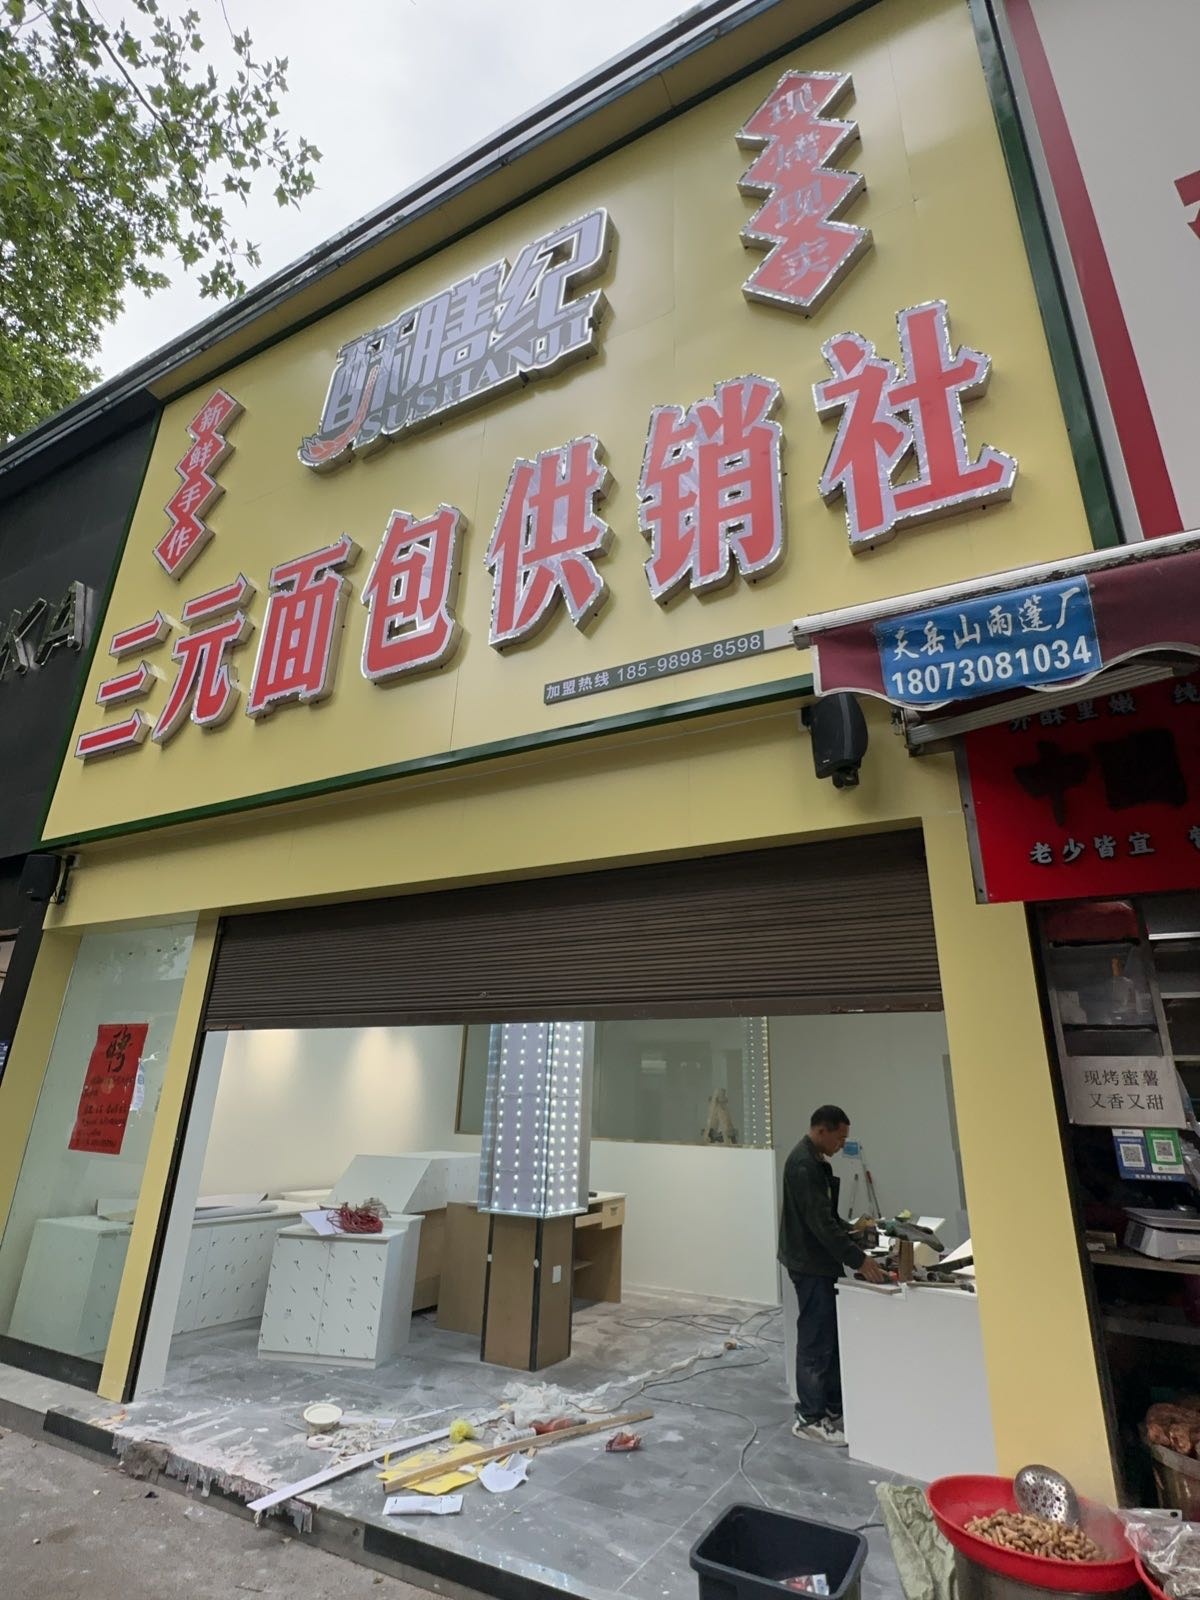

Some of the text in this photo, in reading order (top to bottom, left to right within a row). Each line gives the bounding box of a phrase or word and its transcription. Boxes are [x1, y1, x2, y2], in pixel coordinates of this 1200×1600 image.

[357, 315, 590, 442] SUSHANJI
[166, 400, 226, 560] 新鲜手作
[76, 300, 1015, 757] 三元面包供销社
[546, 634, 762, 700] 加盟热线 185-9898-8598
[891, 635, 1093, 696] 18073081034
[1029, 831, 1156, 865] 老少皆宜
[1084, 1069, 1159, 1087] 现烤蜜薯
[1089, 1093, 1164, 1111] 又香又甜
